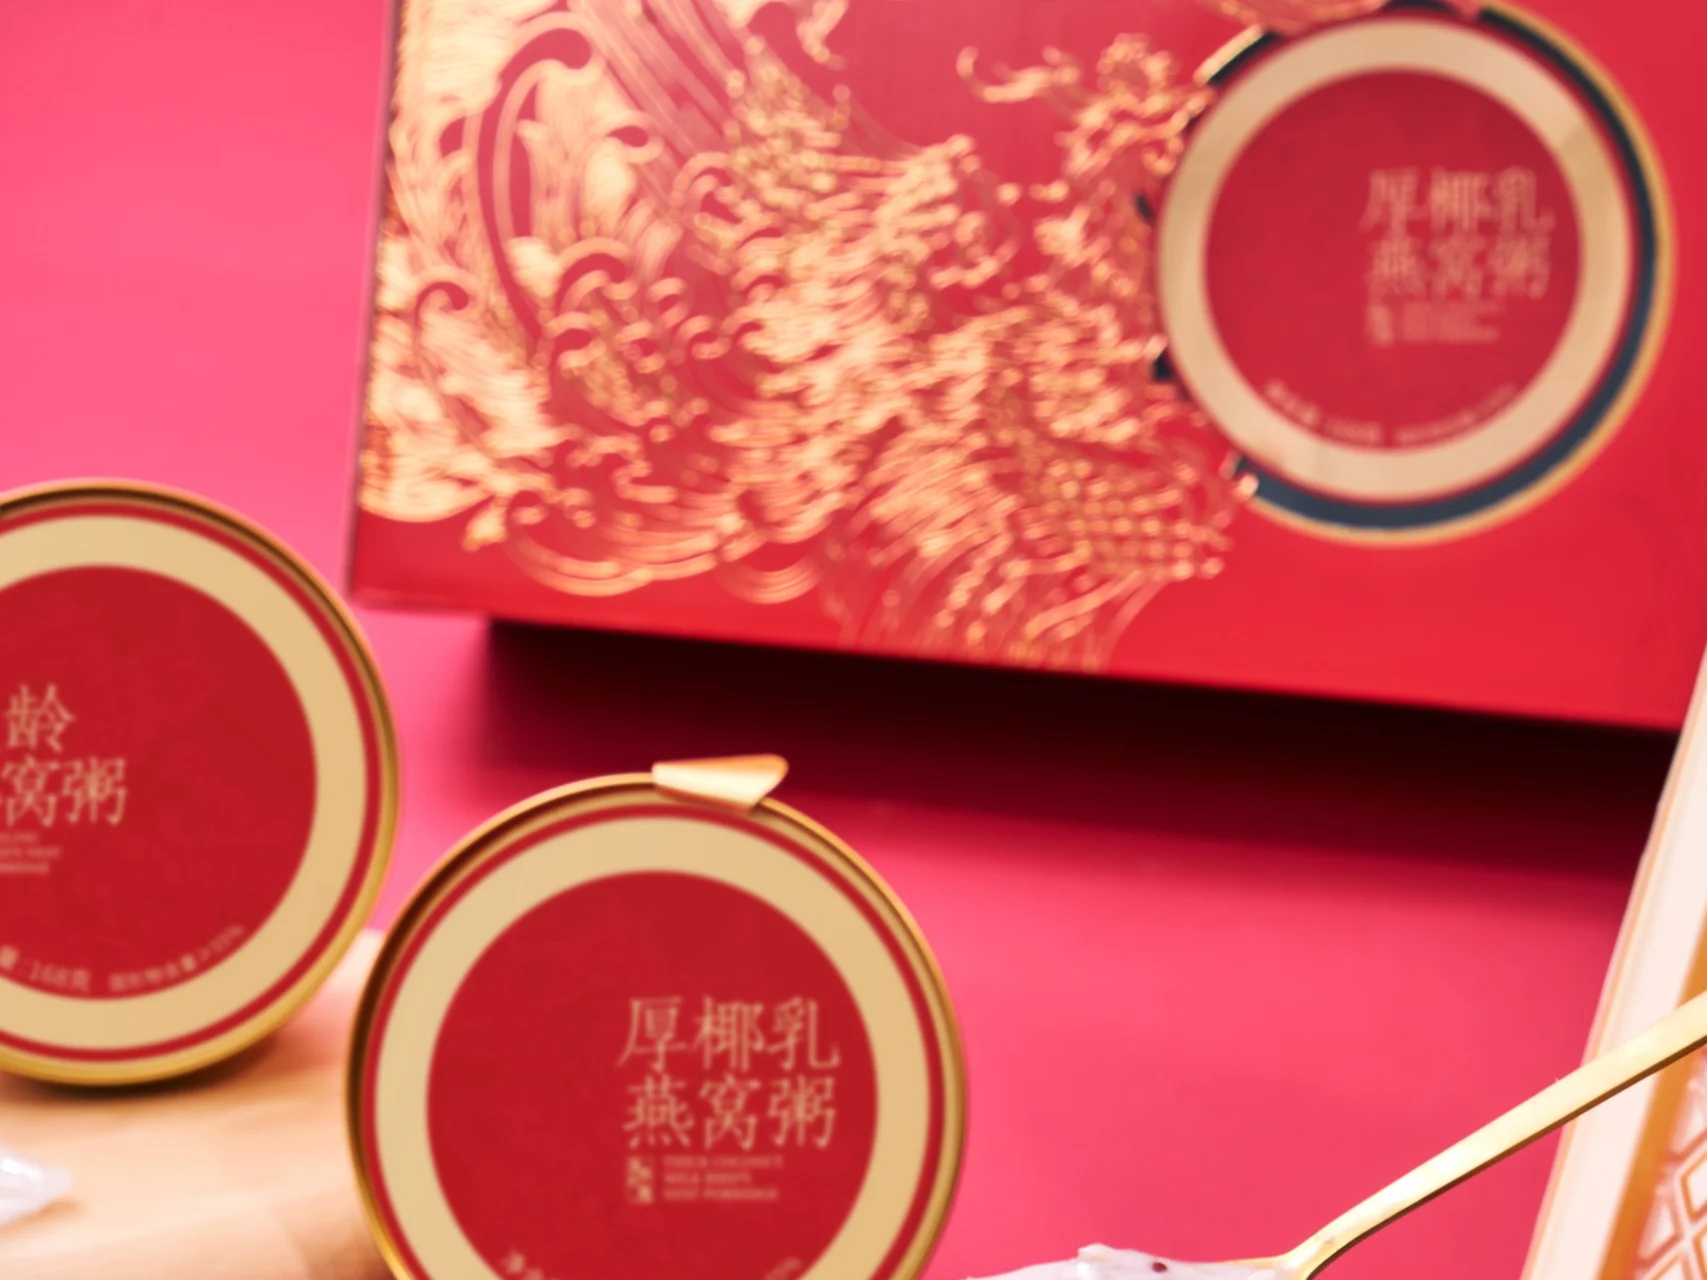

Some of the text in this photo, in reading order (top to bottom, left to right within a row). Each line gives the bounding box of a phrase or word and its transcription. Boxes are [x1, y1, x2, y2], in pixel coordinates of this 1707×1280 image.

[6, 683, 75, 753] 龄
[0, 756, 128, 827] 窝粥
[616, 995, 840, 1073] 厚椰乳
[622, 1073, 838, 1150] 燕窝粥
